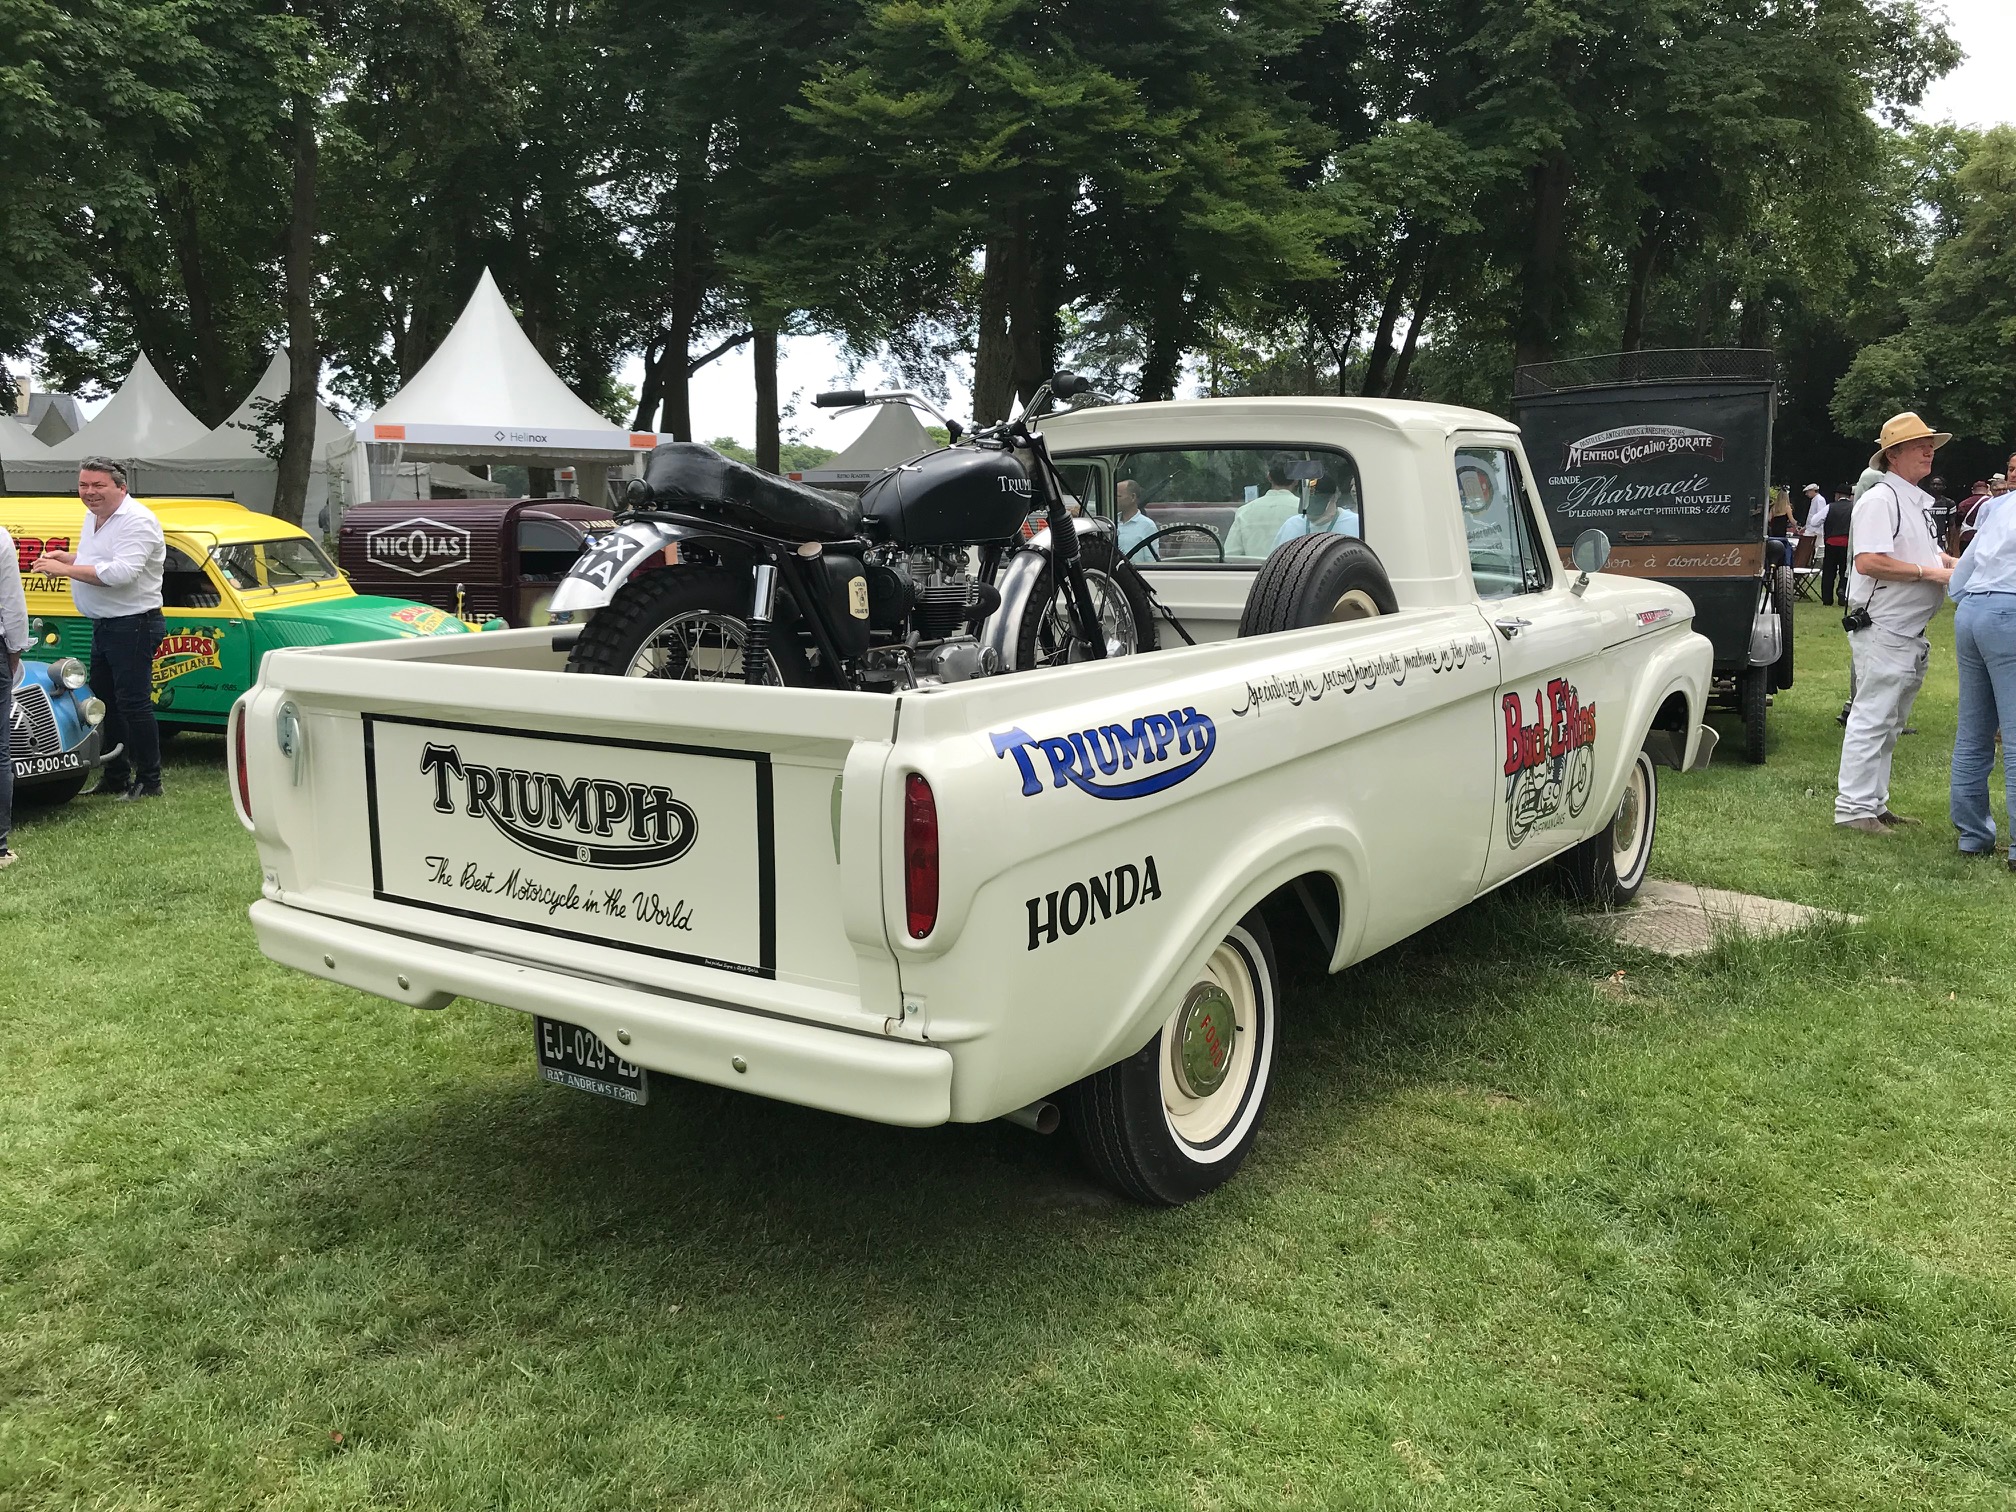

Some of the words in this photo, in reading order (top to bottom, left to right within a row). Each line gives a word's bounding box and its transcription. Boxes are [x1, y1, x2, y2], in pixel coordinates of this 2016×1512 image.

[510, 431, 548, 443] Helinox
[1565, 448, 1620, 472] MENTHOL
[1548, 476, 1581, 486] GRANDE
[1556, 473, 1710, 513] Pharmacie
[1675, 494, 1732, 505] NOUVELLE
[1720, 505, 1731, 514] 16
[375, 529, 461, 563] NICOLAS
[589, 534, 637, 562] SX
[1644, 554, 1657, 568] à
[1666, 547, 1742, 567] domicile
[151, 656, 215, 681] GENTIANE
[1502, 688, 1547, 777] Bud
[989, 707, 1217, 801] TRIUMPH
[420, 741, 699, 870] TRIUMPH
[425, 856, 454, 887] The
[460, 861, 495, 894] Best
[495, 868, 581, 915] Motorcycle
[582, 890, 601, 914] in
[603, 888, 627, 918] the
[632, 892, 693, 932] World
[1025, 855, 1162, 951] HONDA
[1201, 1014, 1223, 1068] FORD
[568, 1075, 612, 1095] ANDREWS
